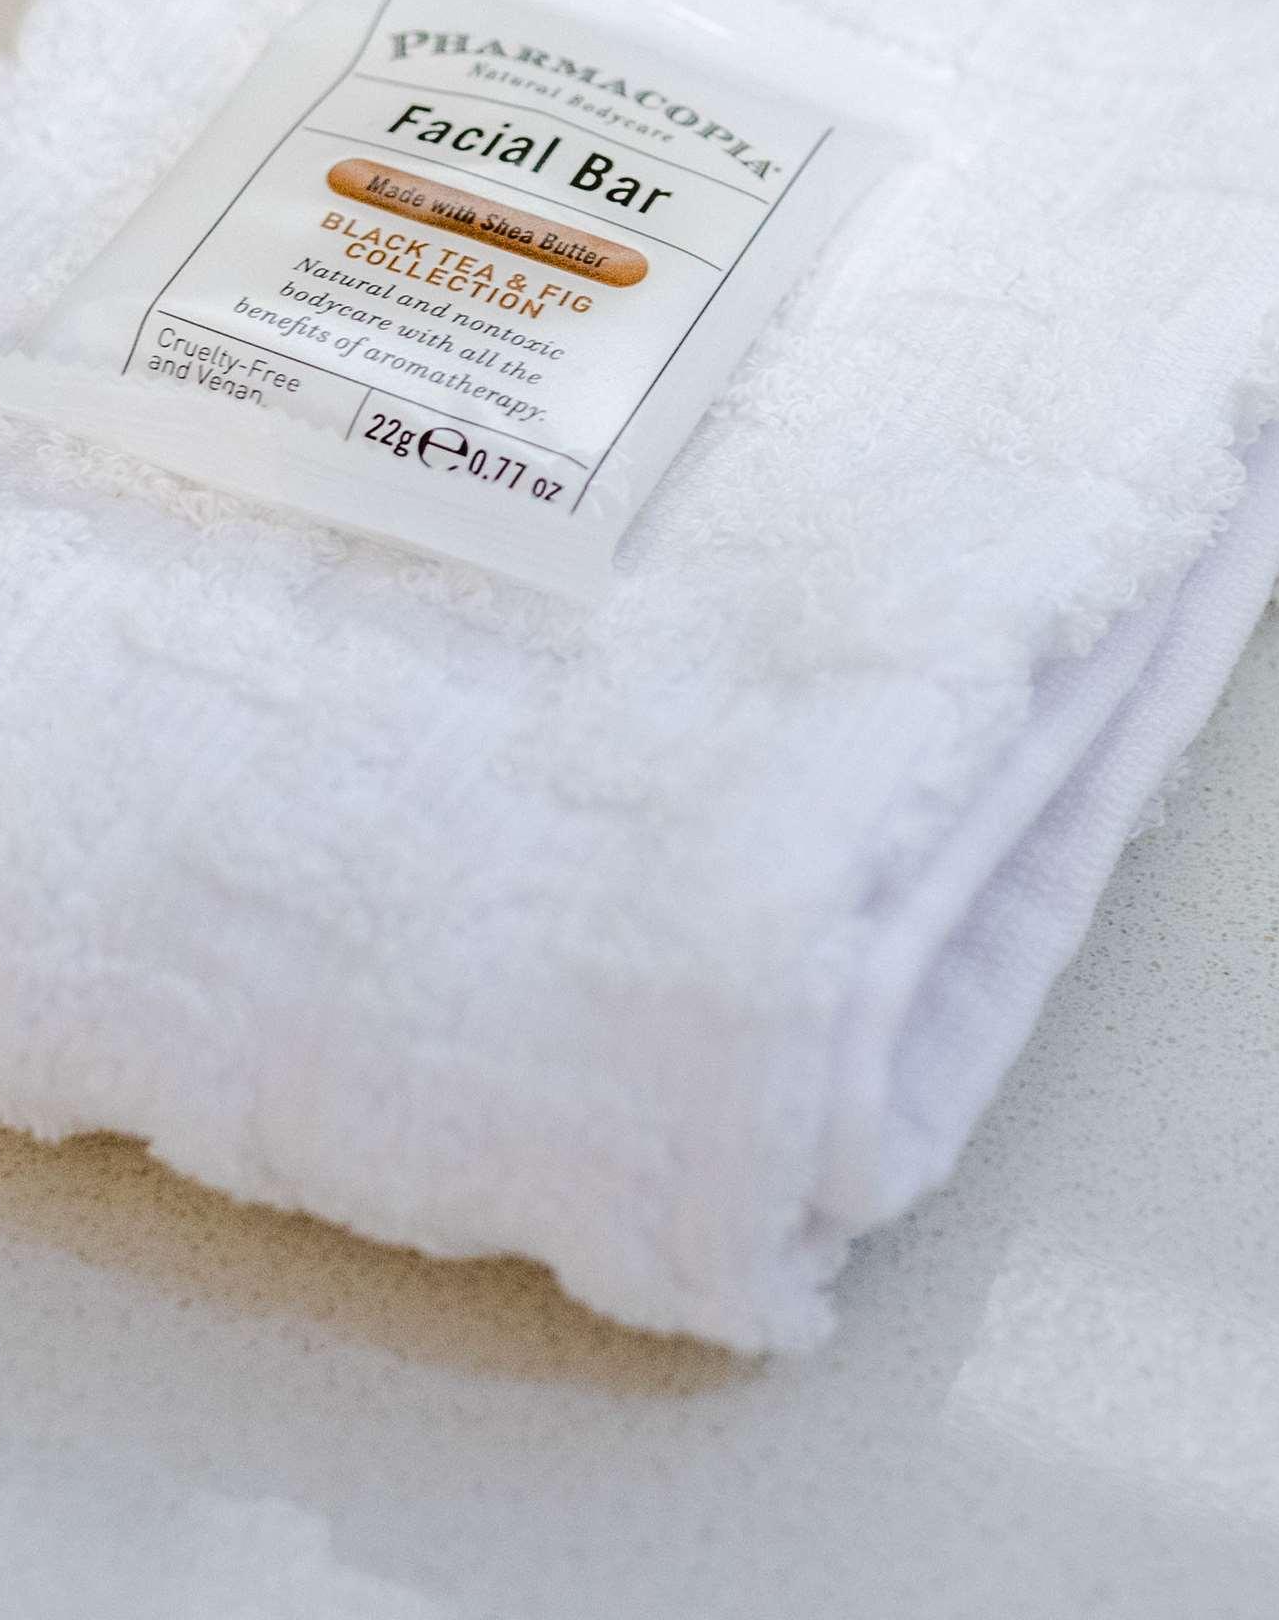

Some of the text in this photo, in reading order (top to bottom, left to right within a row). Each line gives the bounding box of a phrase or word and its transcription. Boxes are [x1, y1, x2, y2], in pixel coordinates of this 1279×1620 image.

[390, 29, 772, 181] PHARMACOPIA
[468, 61, 676, 143] Natural Bodycare
[387, 104, 673, 215] Facial Bar
[320, 211, 595, 314] BLACK TEA & FIG
[366, 174, 610, 269] Made with Shea Butter
[292, 256, 566, 361] Natural and nontoxic
[344, 242, 546, 320] COLLECTION
[148, 354, 192, 380] and
[157, 326, 301, 393] Cruelty-Free
[233, 297, 547, 422] benefits of aromatherapy.
[279, 281, 543, 386] bodycare with all the
[364, 413, 417, 458] 22g
[468, 449, 528, 490] 0.77
[532, 477, 564, 502] oz
